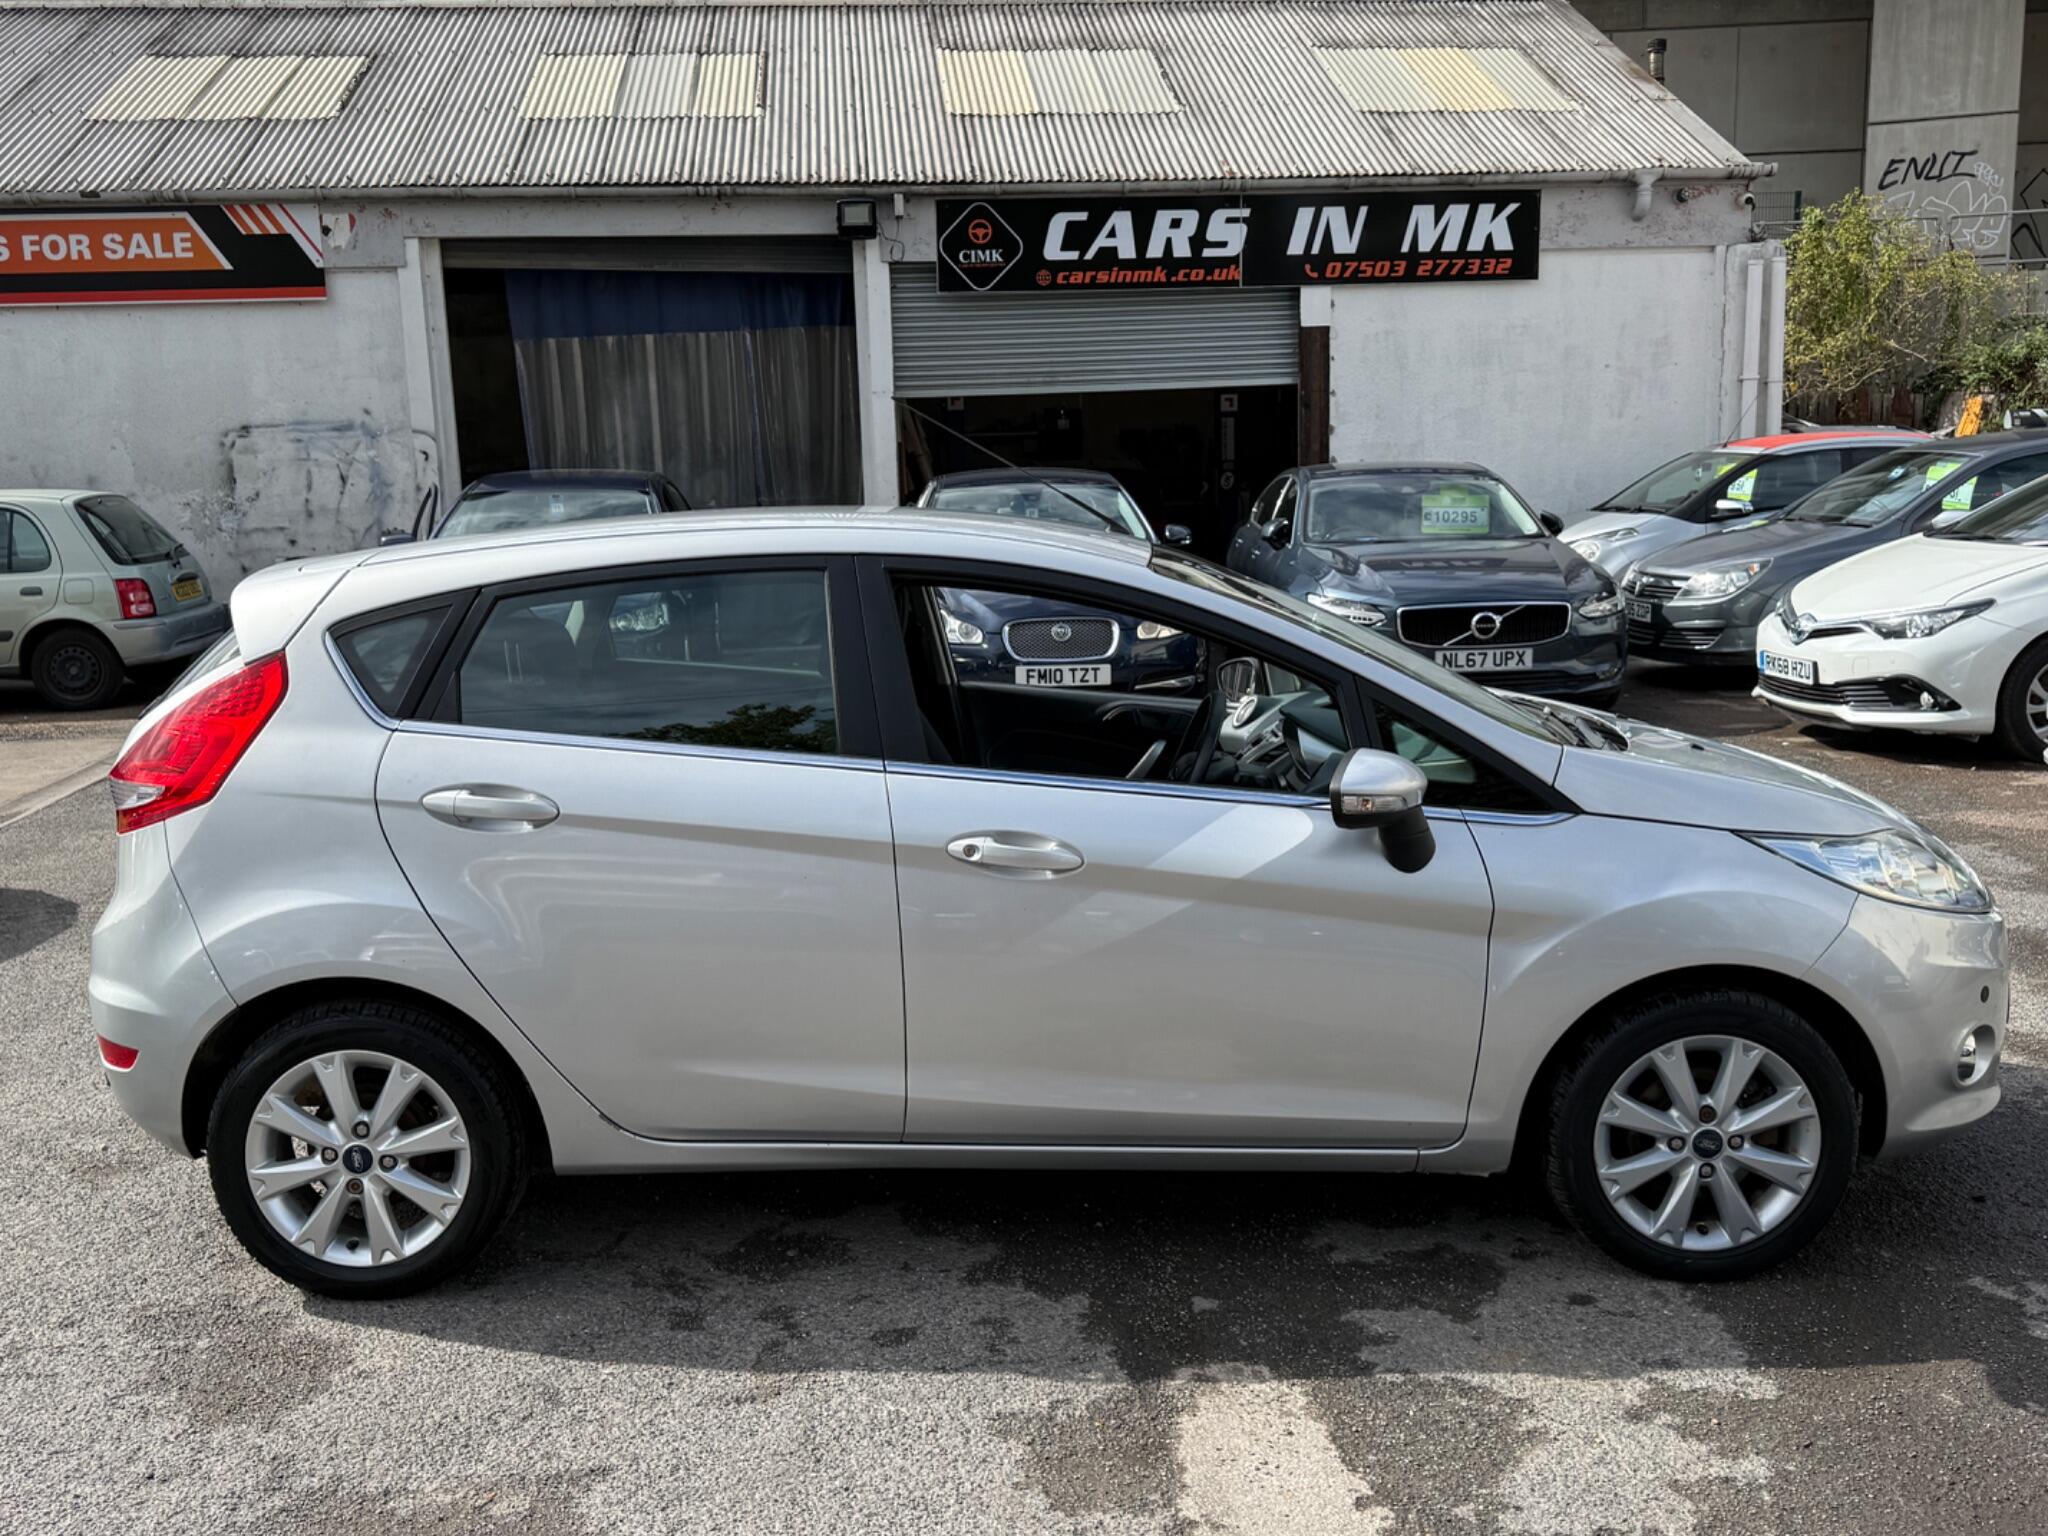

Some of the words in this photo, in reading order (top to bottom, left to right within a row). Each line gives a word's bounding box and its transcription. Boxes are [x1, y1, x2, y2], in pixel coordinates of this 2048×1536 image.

[1043, 208, 1251, 260] CARS
[1286, 206, 1369, 255] IN
[1401, 203, 1521, 252] MK
[22, 233, 92, 260] FOR
[102, 232, 194, 259] SALE
[959, 249, 1003, 263] CIMK
[1056, 264, 1241, 285] carsinmk.co.uk
[1325, 260, 1408, 278] 07503
[1417, 258, 1513, 275] 277332
[1442, 653, 1488, 668] NL67
[1493, 651, 1526, 666] UPX
[1026, 668, 1063, 684] FM10
[1069, 667, 1100, 683] TZT
